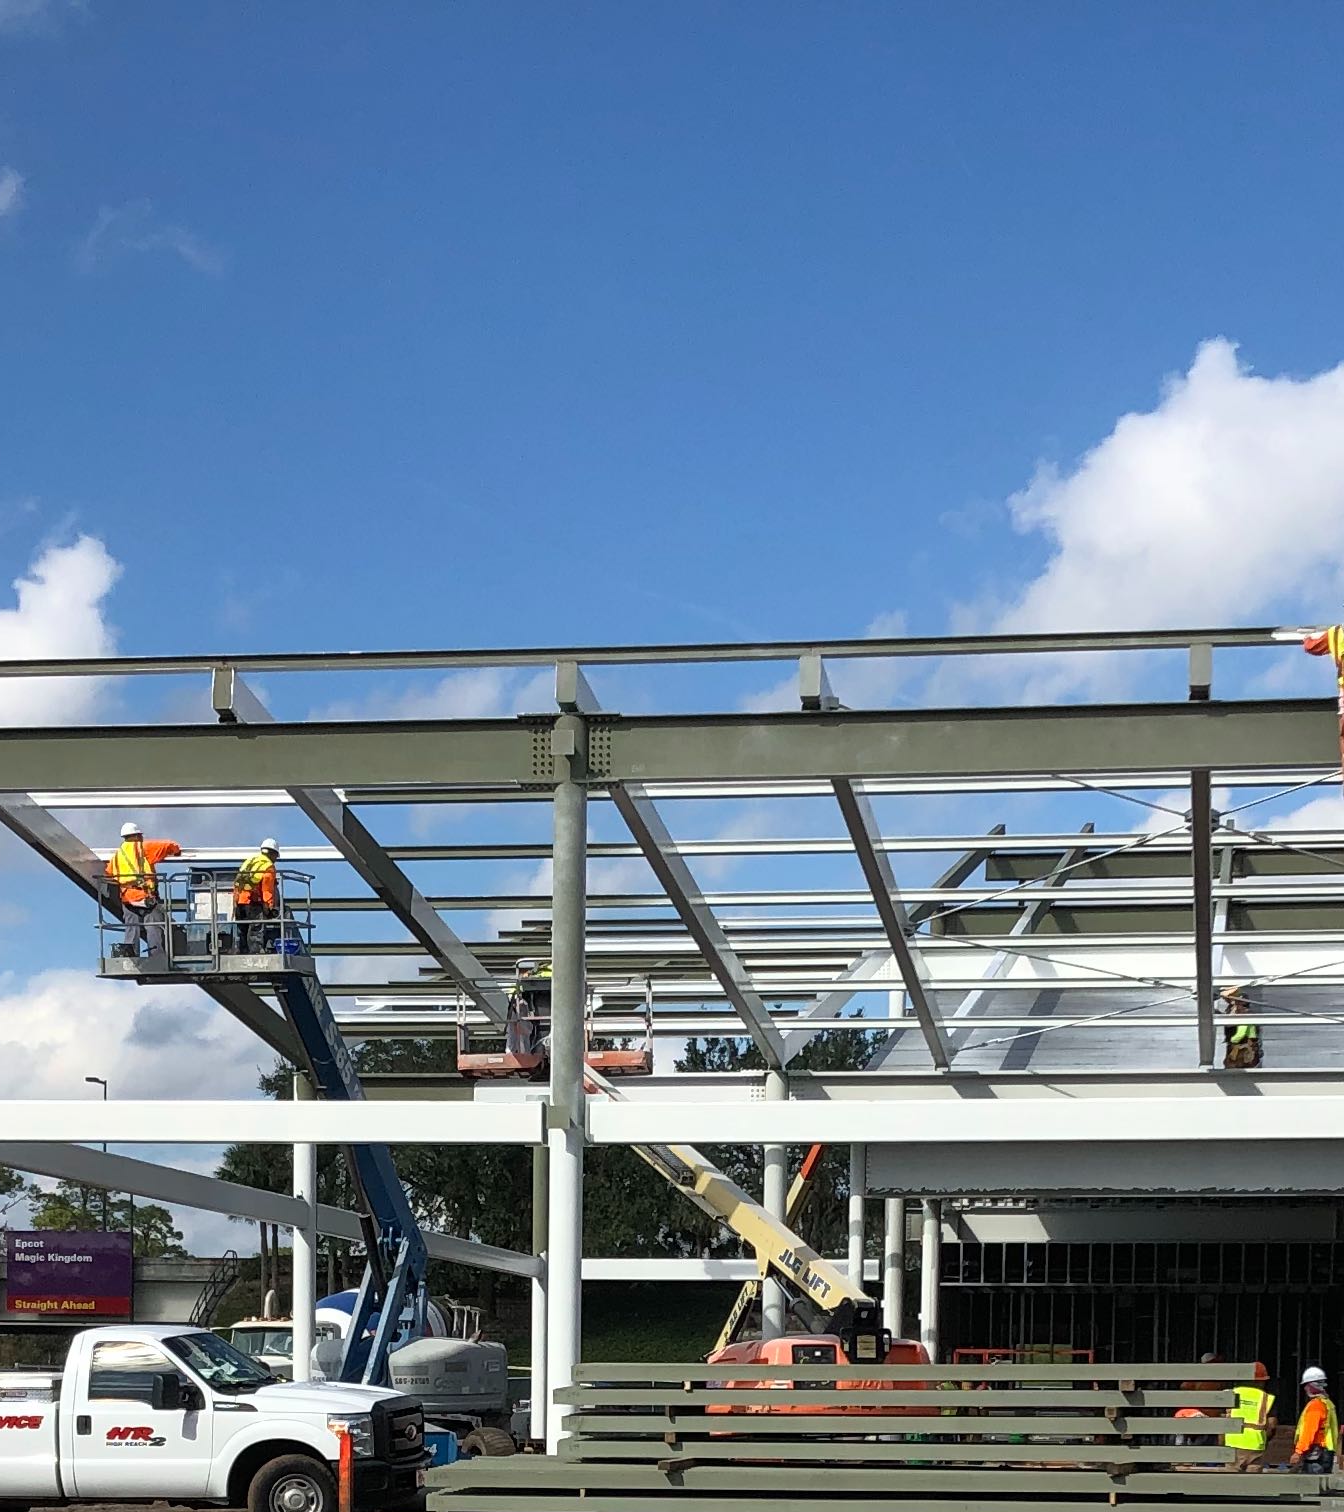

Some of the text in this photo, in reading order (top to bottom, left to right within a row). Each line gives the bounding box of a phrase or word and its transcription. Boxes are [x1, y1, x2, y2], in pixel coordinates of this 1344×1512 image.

[15, 1239, 44, 1250] Epcot
[15, 1253, 93, 1264] Magic Kingdom
[778, 1248, 832, 1299] JLG LIFT
[15, 1300, 96, 1311] Straight Ahead
[106, 1426, 167, 1447] HR 2
